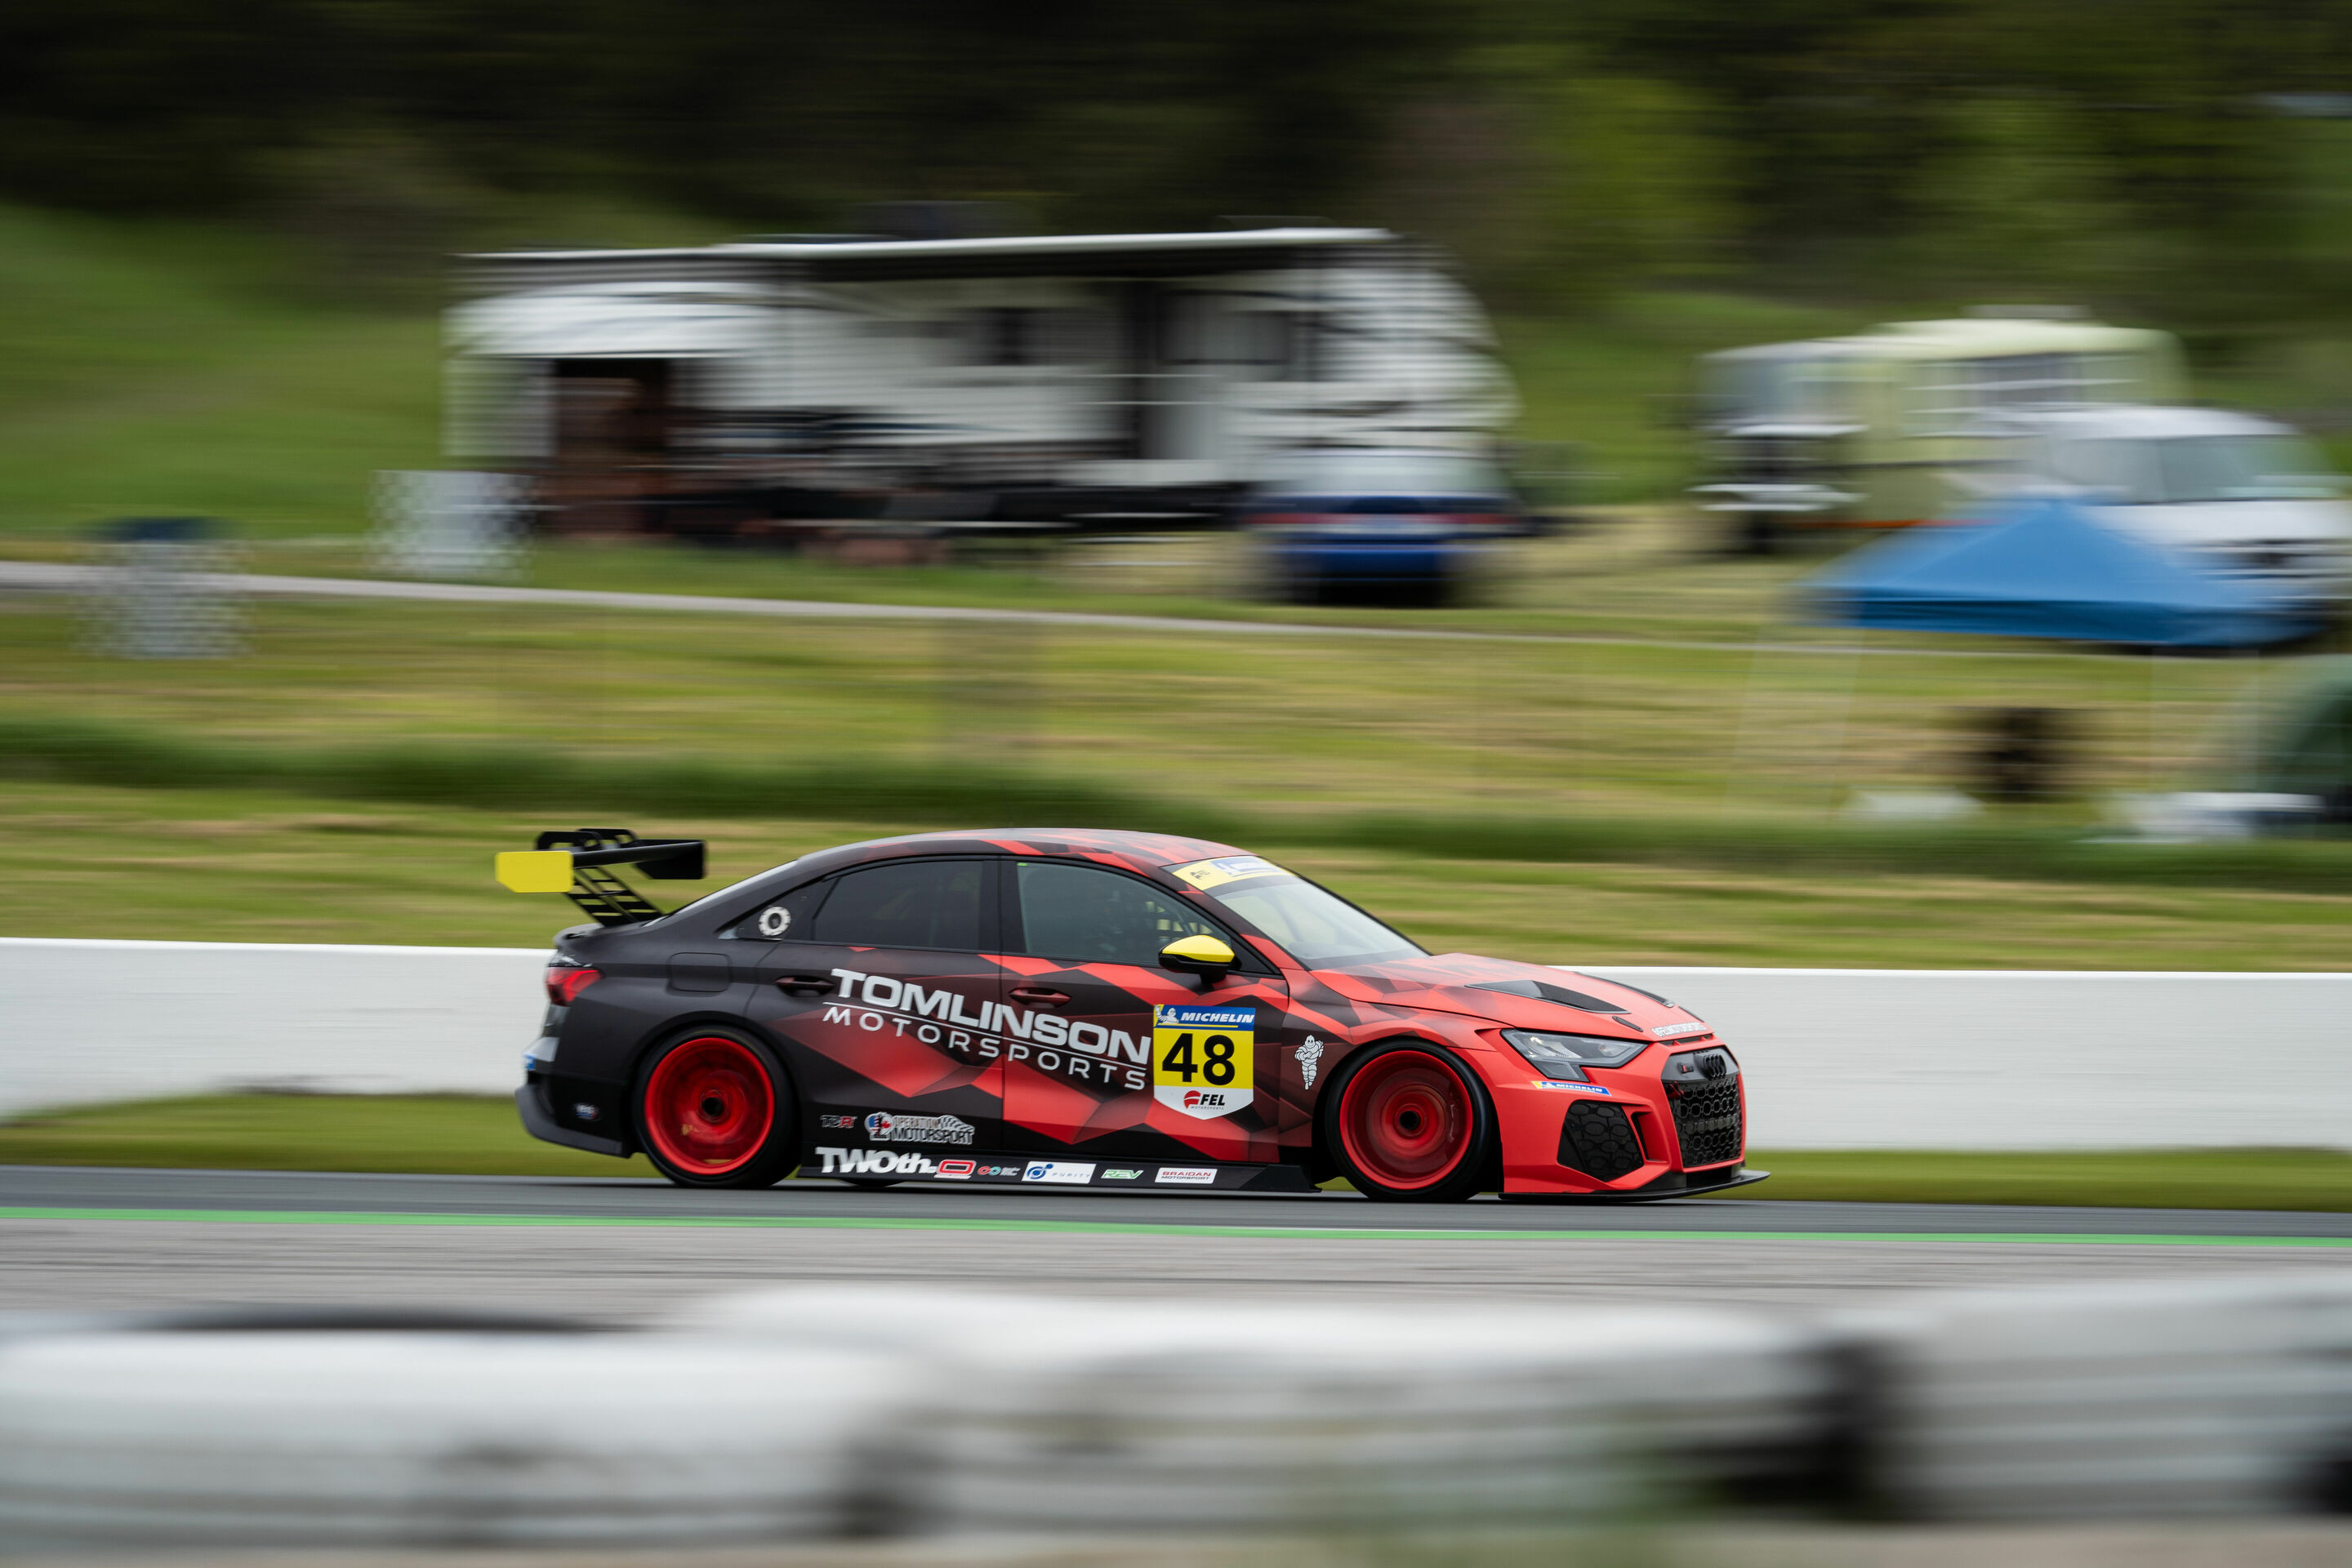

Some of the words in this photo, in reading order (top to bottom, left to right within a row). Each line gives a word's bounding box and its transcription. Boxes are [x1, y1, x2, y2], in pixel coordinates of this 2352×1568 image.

[831, 969, 1152, 1064] TOMLINSON
[1180, 1012, 1255, 1023] MICHELIN
[822, 1006, 1146, 1090] MOTORSPORTS
[1162, 1033, 1235, 1085] 48
[1556, 1084, 1602, 1093] MICHELIN
[1200, 1094, 1226, 1106] FEL
[1102, 1169, 1143, 1178] REV
